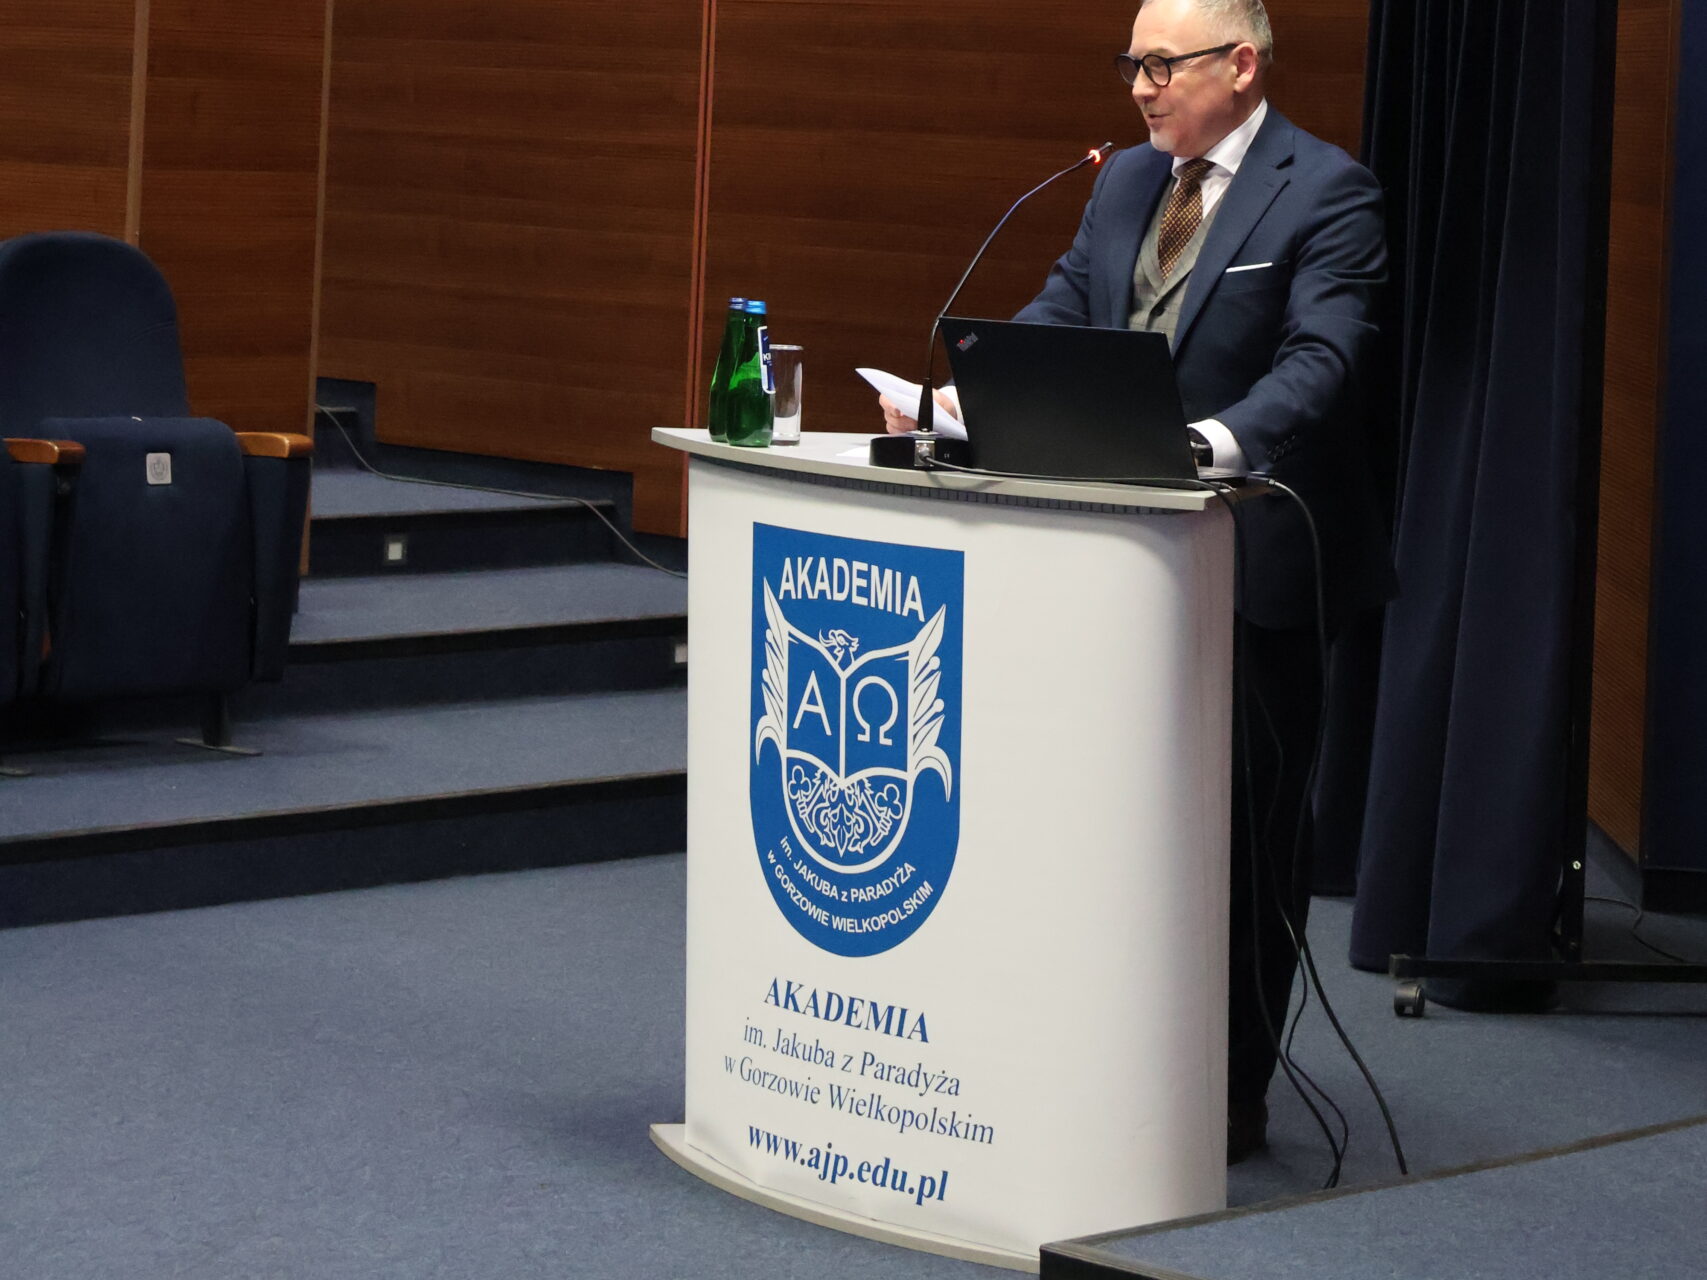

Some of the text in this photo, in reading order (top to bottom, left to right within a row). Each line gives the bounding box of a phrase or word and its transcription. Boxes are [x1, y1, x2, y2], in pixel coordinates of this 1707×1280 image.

[779, 556, 926, 623] AKADEMIA
[767, 849, 935, 933] w GORZOWIE WIELKOPOLSKIM
[780, 835, 917, 903] im. JAKUBA z PARADYŻA
[763, 977, 930, 1043] AKADEMIA
[743, 1016, 961, 1098] im. Jakuba z Paradyża
[724, 1055, 994, 1146] w Gorzowie Wielkopolskim
[748, 1124, 949, 1206] www.ajp.edu.pl
